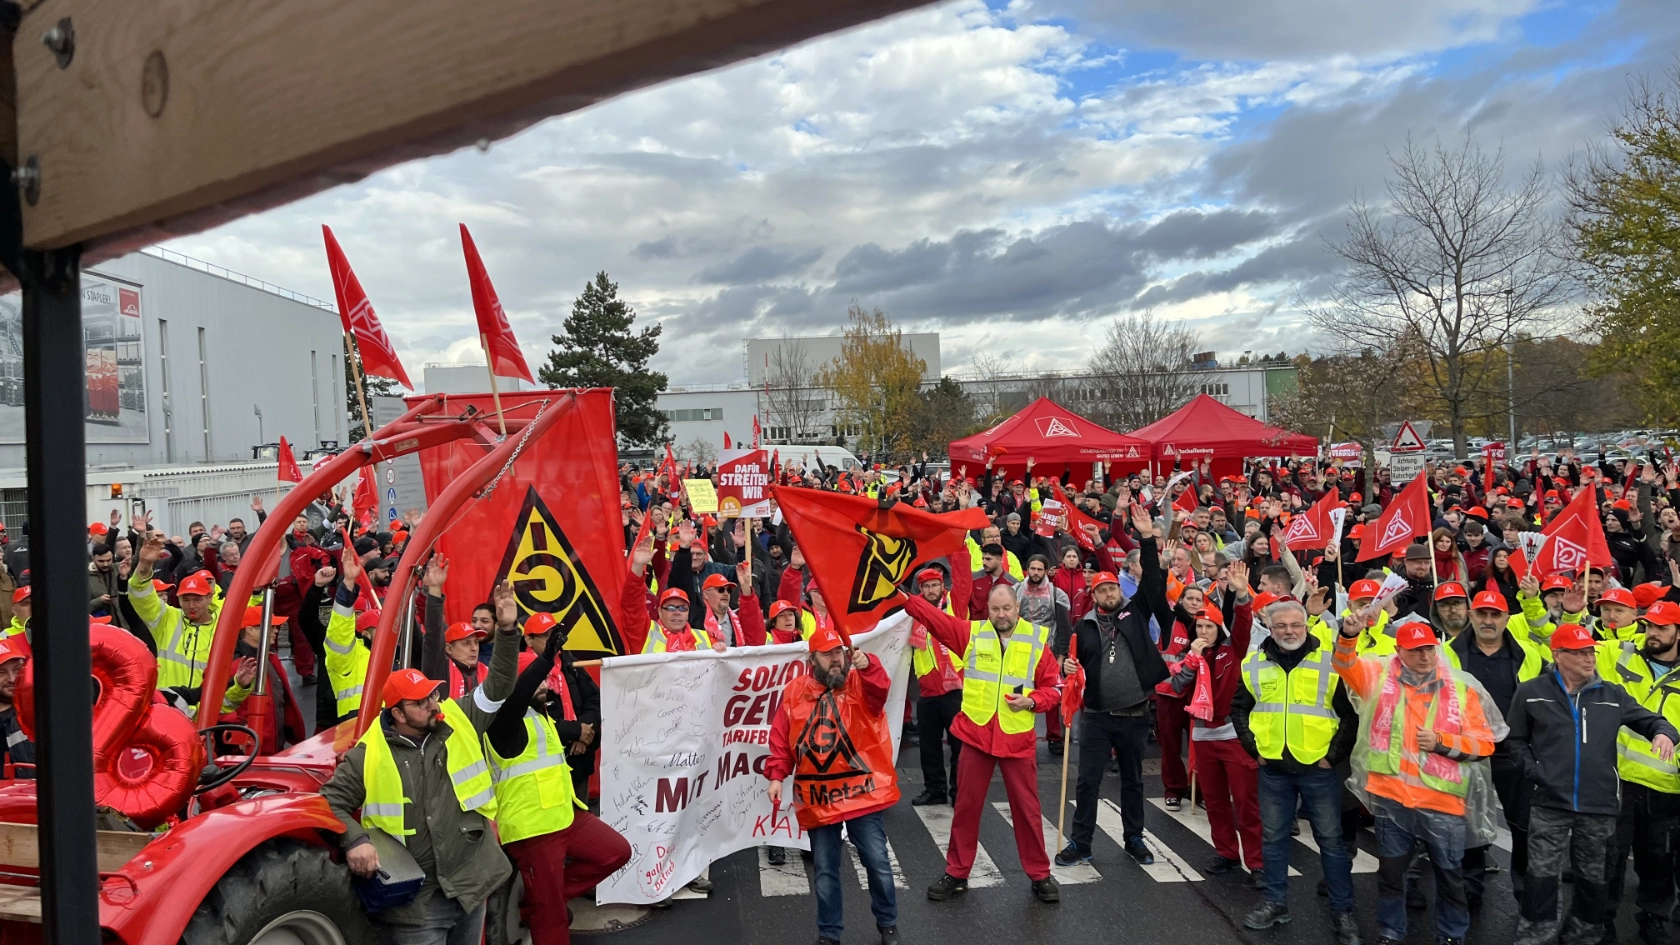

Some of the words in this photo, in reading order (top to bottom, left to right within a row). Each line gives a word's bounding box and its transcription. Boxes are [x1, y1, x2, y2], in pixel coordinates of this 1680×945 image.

[735, 462, 760, 473] DAFÜR
[720, 473, 768, 486] STREITEN
[1393, 471, 1421, 479] Rutschgef
[743, 486, 763, 499] WIR
[724, 502, 736, 510] 8%
[723, 730, 770, 748] TARIFB
[655, 771, 710, 813] MIT
[713, 751, 793, 791] MAC
[809, 777, 876, 806] Metall
